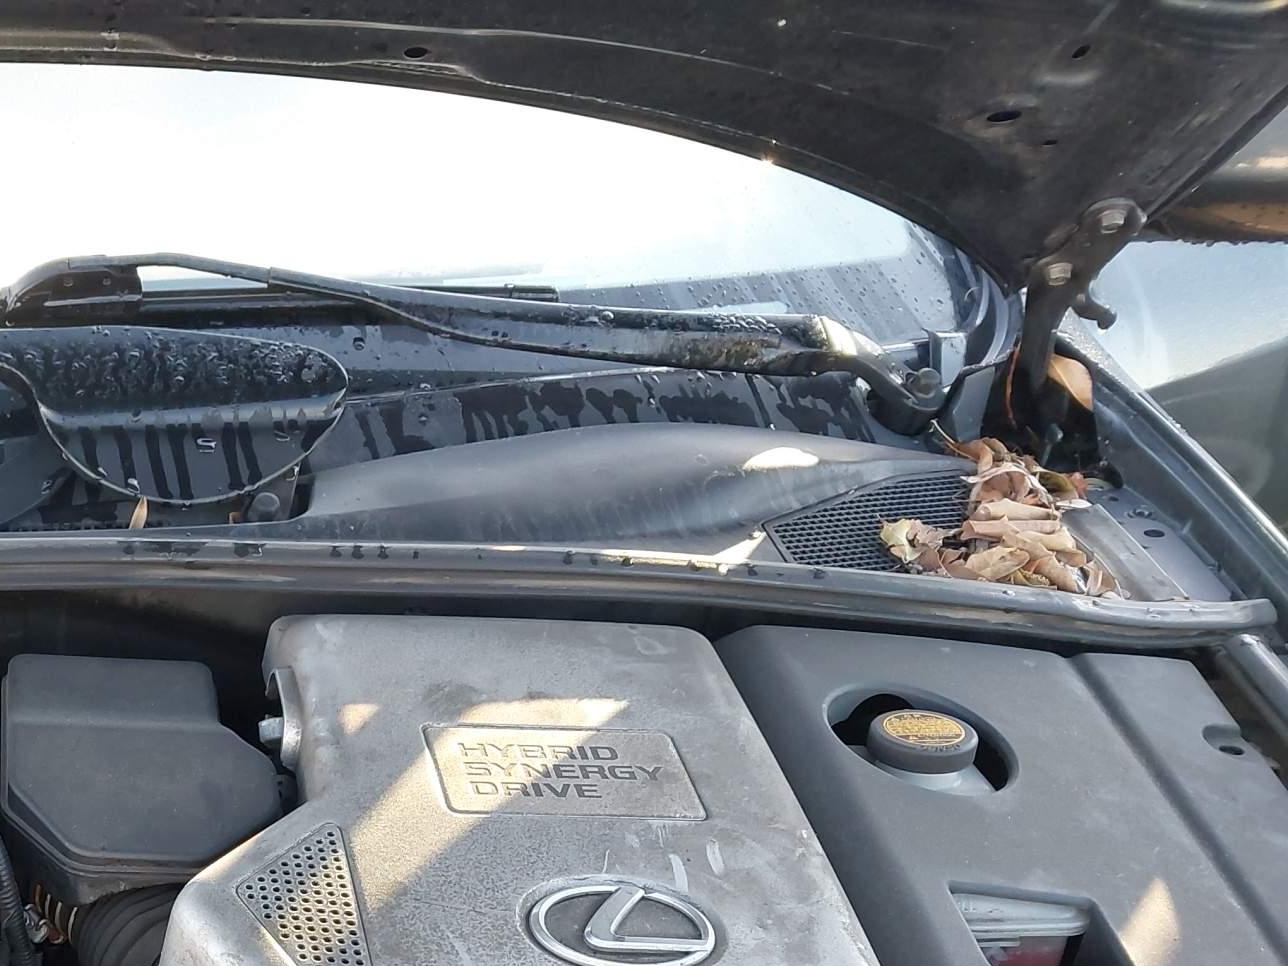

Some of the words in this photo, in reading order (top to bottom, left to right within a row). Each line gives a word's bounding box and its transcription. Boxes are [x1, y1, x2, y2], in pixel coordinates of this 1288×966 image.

[457, 742, 618, 760] HYBRID
[463, 761, 663, 781] SYNERGY
[469, 780, 602, 799] DRIVE
